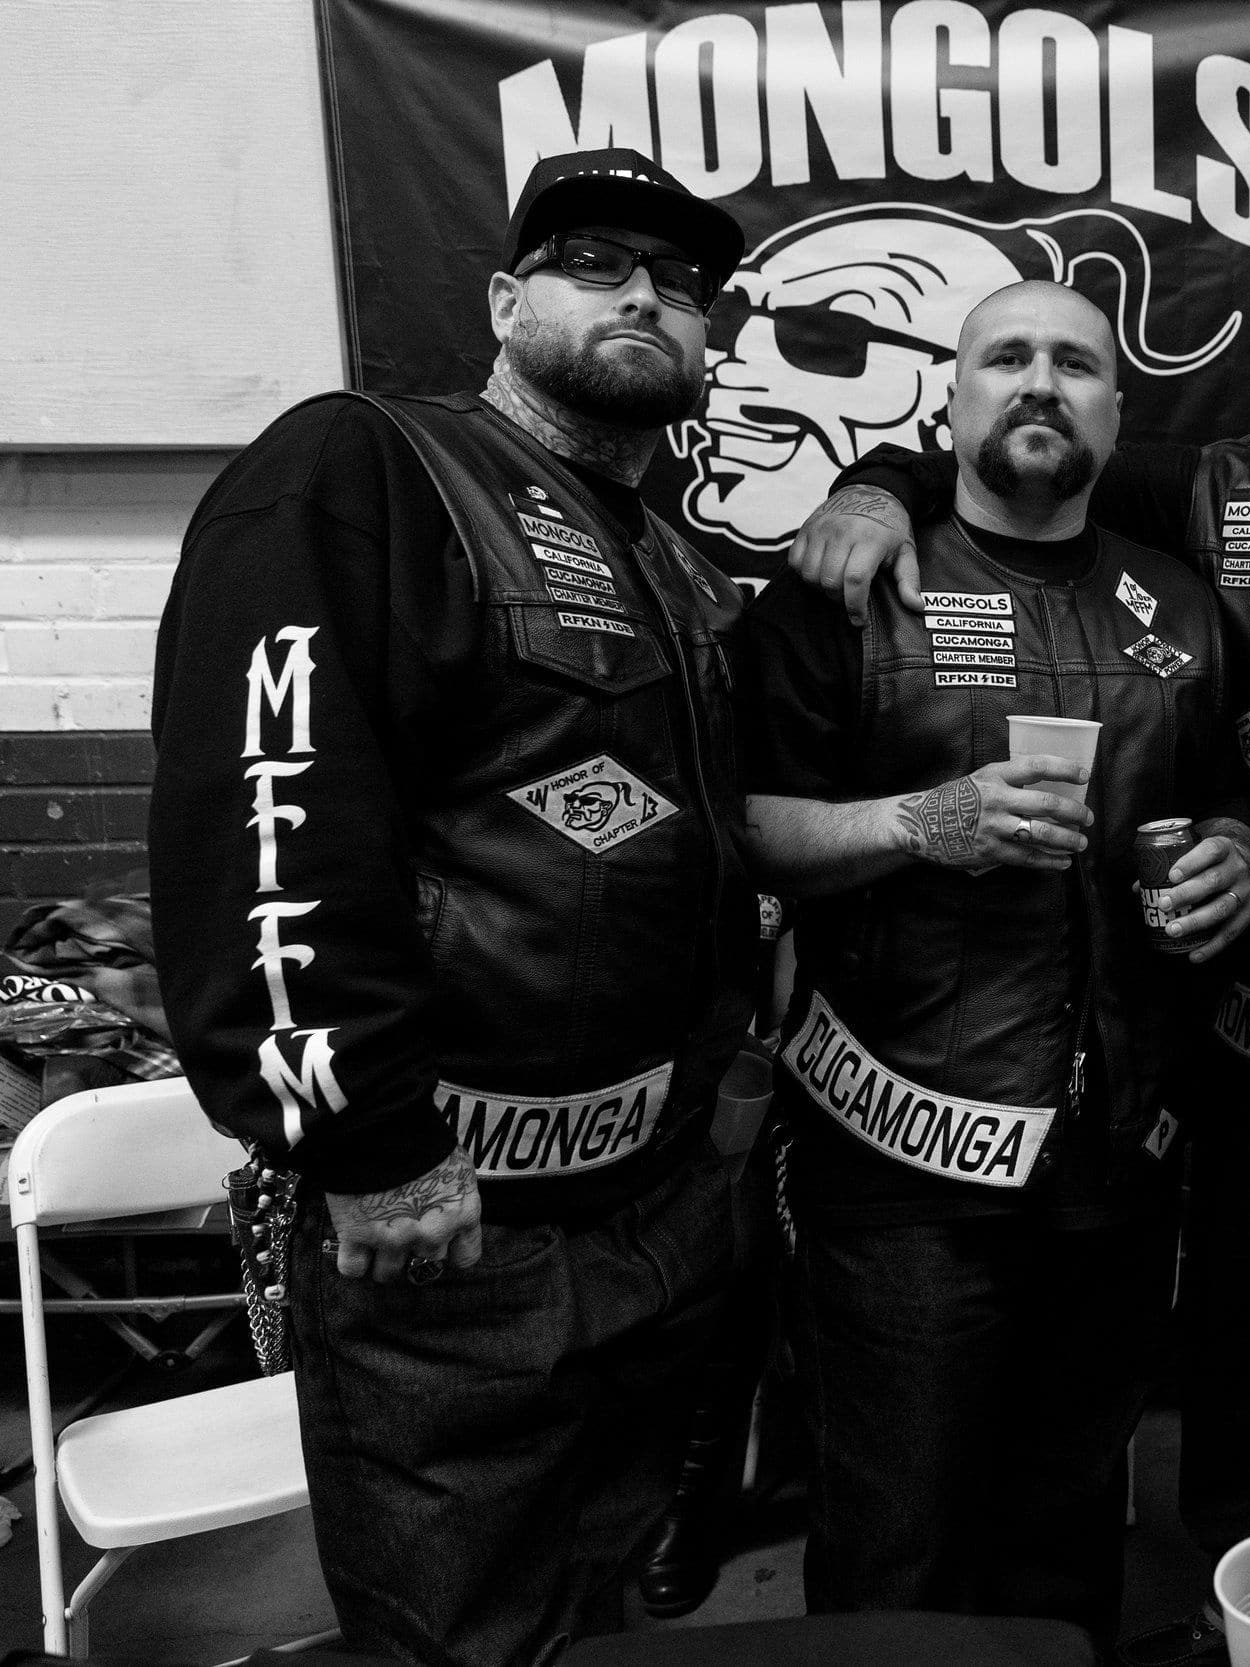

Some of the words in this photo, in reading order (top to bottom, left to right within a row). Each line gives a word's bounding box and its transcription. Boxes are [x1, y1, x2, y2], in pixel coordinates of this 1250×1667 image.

[523, 517, 598, 553] MONGOLS
[543, 549, 605, 574] CALIFORNIA
[549, 568, 615, 592] CUCAMONGA
[925, 595, 1009, 611] MONGOLS
[562, 614, 601, 628] RFKN
[936, 618, 1004, 631] CALIFORNIA
[935, 635, 1011, 648] CUCAMONGA
[935, 652, 976, 664] CHARTER
[978, 653, 1014, 666] MEMBER
[938, 673, 979, 684] RFKN
[550, 769, 588, 791] HONOR
[591, 761, 605, 774] OF
[593, 819, 638, 847] CHAPTER
[240, 626, 347, 1150] MFFM
[797, 1012, 1026, 1177] CUCAMONGA
